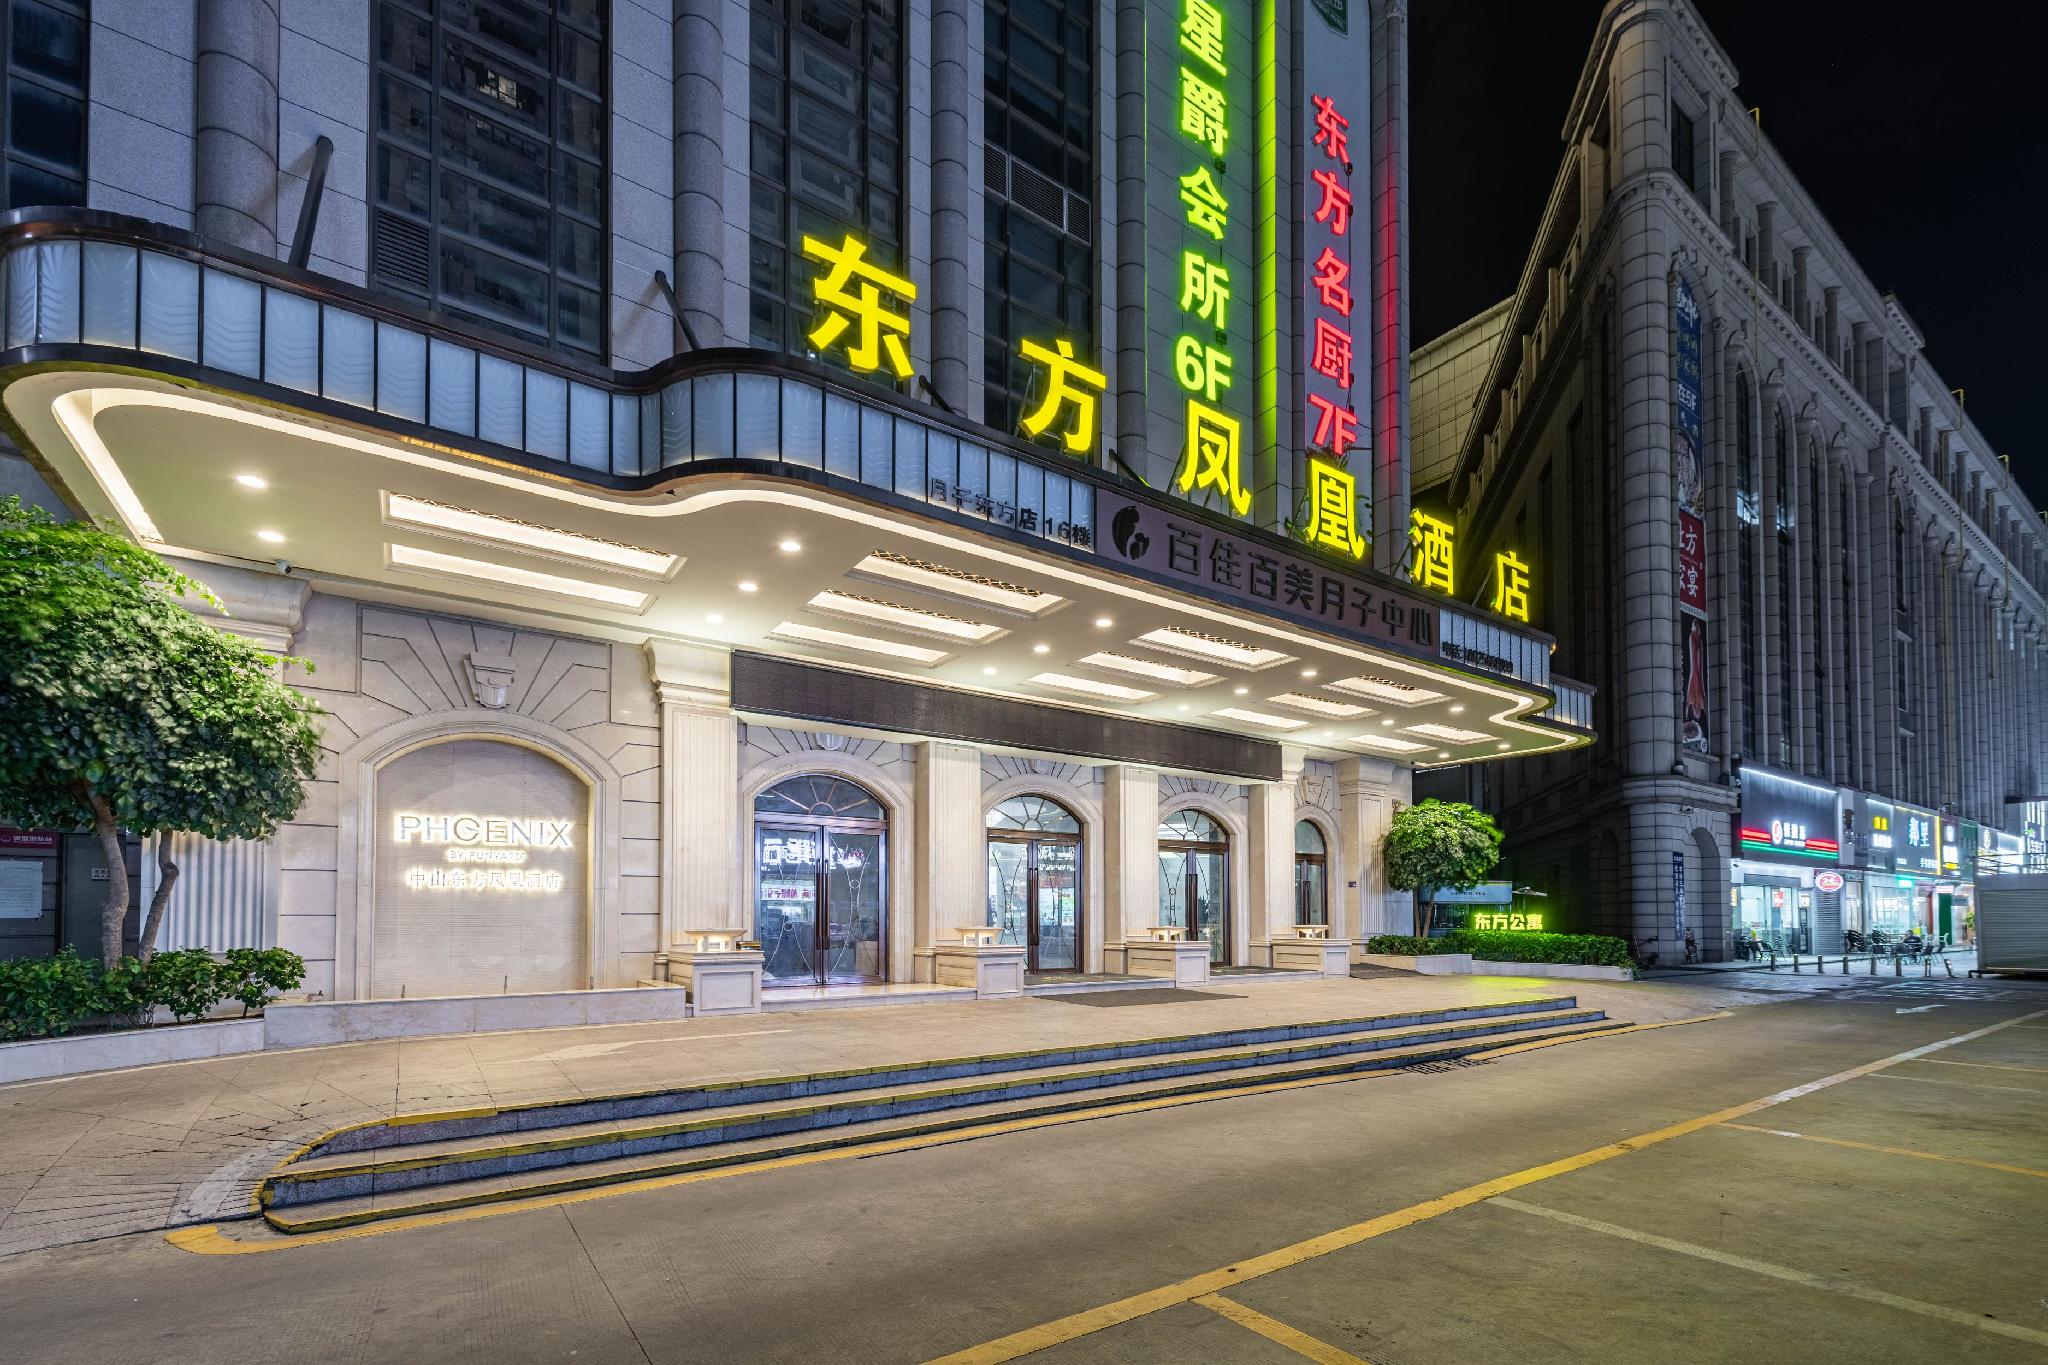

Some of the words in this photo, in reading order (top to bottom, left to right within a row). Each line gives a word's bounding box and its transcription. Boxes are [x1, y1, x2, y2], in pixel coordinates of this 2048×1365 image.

[1308, 93, 1358, 456] 东方名厨7F
[802, 234, 1530, 624] 东方凤凰酒店
[1166, 522, 1434, 647] 百佳百美月子中心
[400, 815, 569, 846] PHOENIX
[450, 850, 464, 860] BY
[410, 867, 561, 889] 中山东方凤凰酒店
[1474, 913, 1543, 931] 东方公寓
